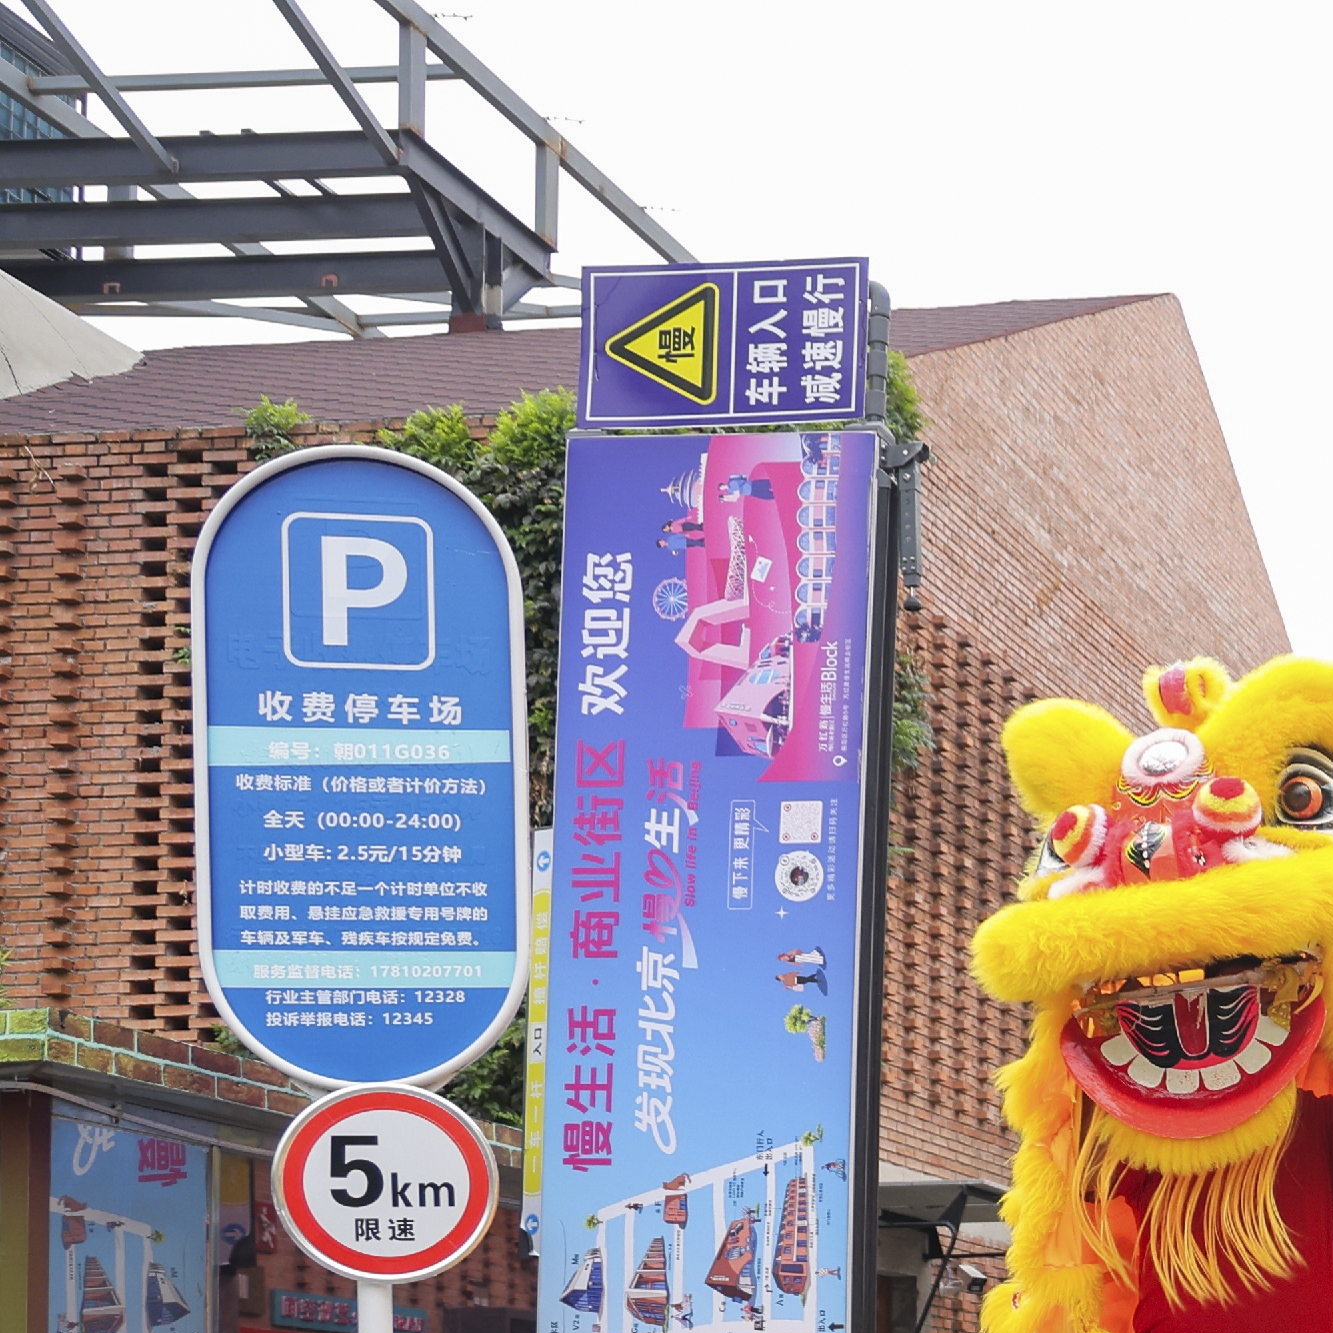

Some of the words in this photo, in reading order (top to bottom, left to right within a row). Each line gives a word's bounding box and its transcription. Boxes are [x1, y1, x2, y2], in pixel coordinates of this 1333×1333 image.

[657, 326, 695, 363] 慢
[745, 279, 788, 405] 车辆入口
[800, 274, 845, 403] 减速慢行
[321, 536, 407, 646] P
[578, 552, 633, 716] 欢迎您
[820, 641, 839, 681] Block
[258, 691, 462, 725] 收费停车场
[235, 774, 486, 795] 收费标准（价格或者计价方法）
[687, 760, 702, 811] Beijing
[685, 827, 696, 841] in
[733, 807, 750, 850] 更精彩
[684, 845, 696, 869] life
[239, 880, 487, 897] 计时收费的不足一个计时单位不收
[684, 873, 696, 907] Slow
[733, 857, 749, 899] 慢下来
[240, 905, 487, 922] 取费用、悬挂应急救援专用号牌的
[241, 930, 480, 946] 车辆及军车、残疾车按规定免费。
[534, 910, 548, 1004] 撞杆赔偿
[532, 1028, 543, 1056] 入口
[527, 1081, 544, 1174] 一车一杆
[329, 1135, 456, 1208] 5km
[354, 1218, 416, 1242] 限速
